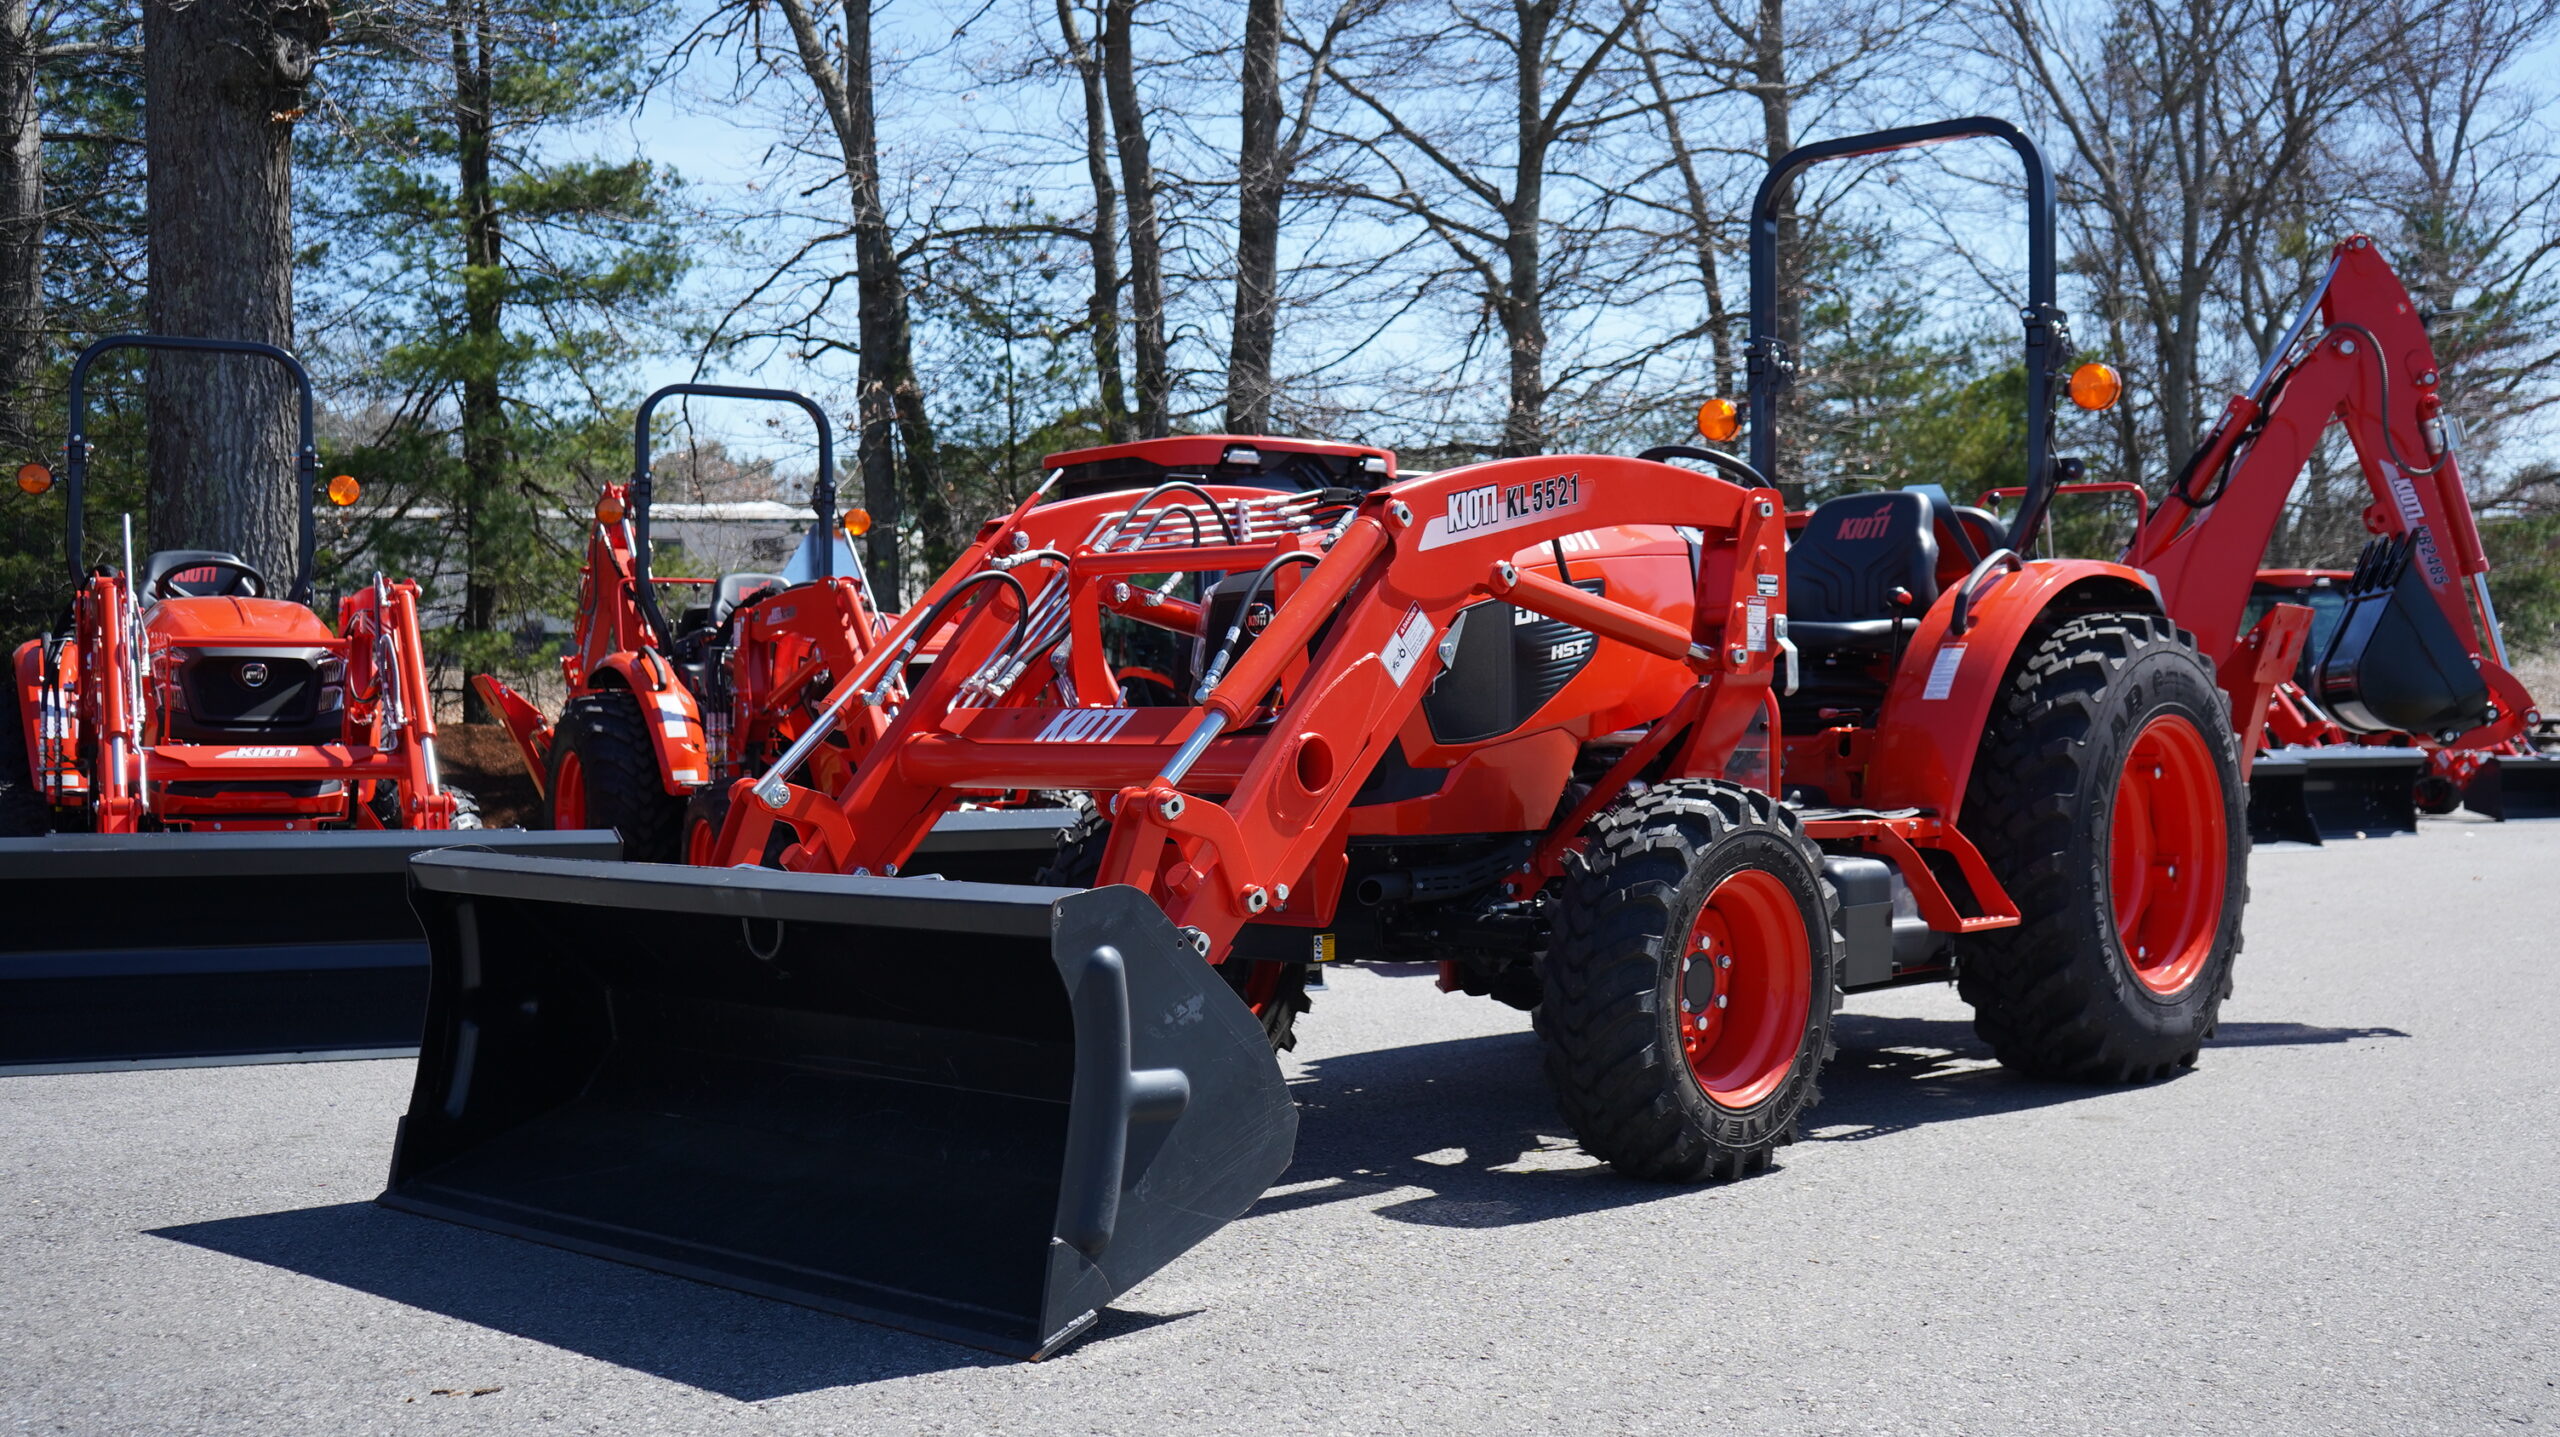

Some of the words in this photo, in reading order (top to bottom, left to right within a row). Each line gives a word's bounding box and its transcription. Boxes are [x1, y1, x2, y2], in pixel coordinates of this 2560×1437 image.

[1447, 483, 1499, 533] KIOTI
[2392, 478, 2425, 520] KIOTI
[1836, 515, 1891, 540] KIOTI
[1551, 638, 1586, 660] HST
[1033, 709, 1138, 742] KIOTI
[236, 747, 299, 758] KIOTI
